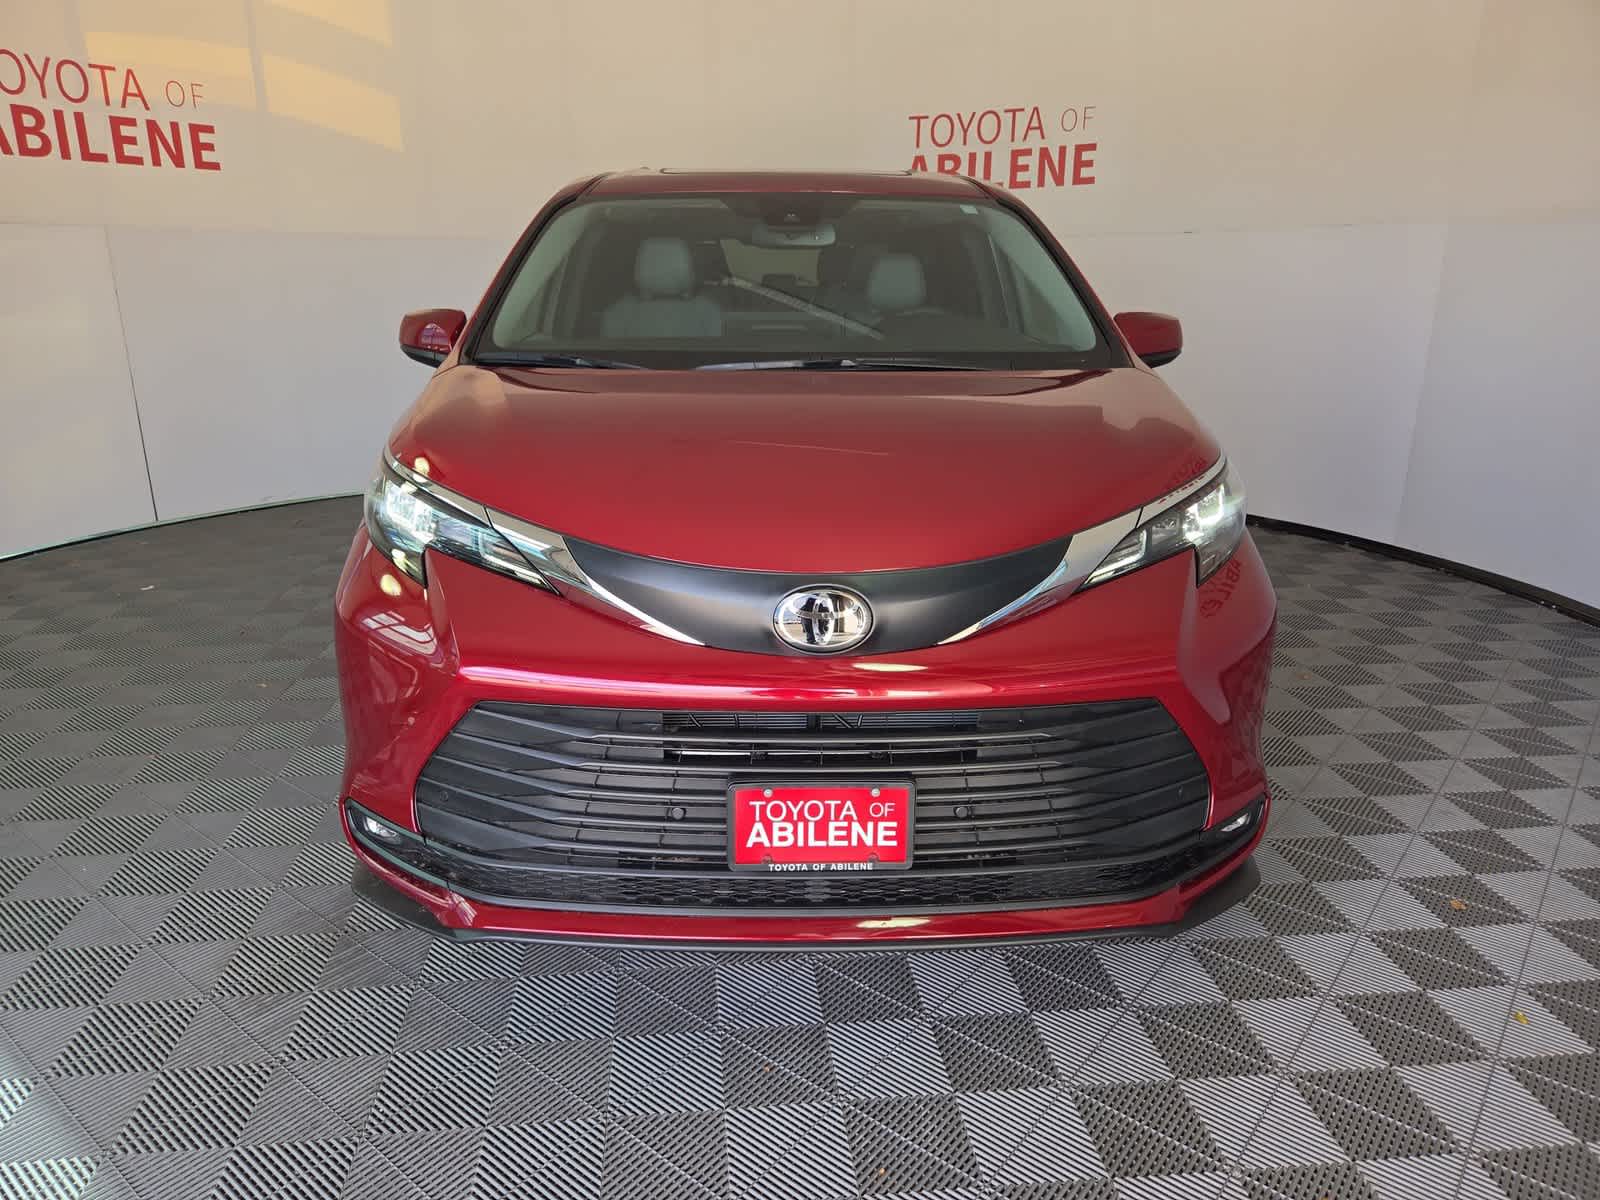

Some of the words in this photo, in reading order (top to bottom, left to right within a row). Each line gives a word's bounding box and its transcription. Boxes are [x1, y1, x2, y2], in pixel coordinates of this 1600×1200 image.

[0, 49, 150, 111] OYOTA
[165, 80, 204, 109] OF
[908, 106, 1045, 148] TOYOTA
[1061, 106, 1097, 132] OF
[749, 800, 857, 821] TOYOTA
[869, 802, 895, 818] OF
[746, 821, 898, 848] ABILENE
[768, 863, 808, 872] TOYOTA
[812, 863, 826, 871] OF
[830, 862, 873, 871] ABILENE
